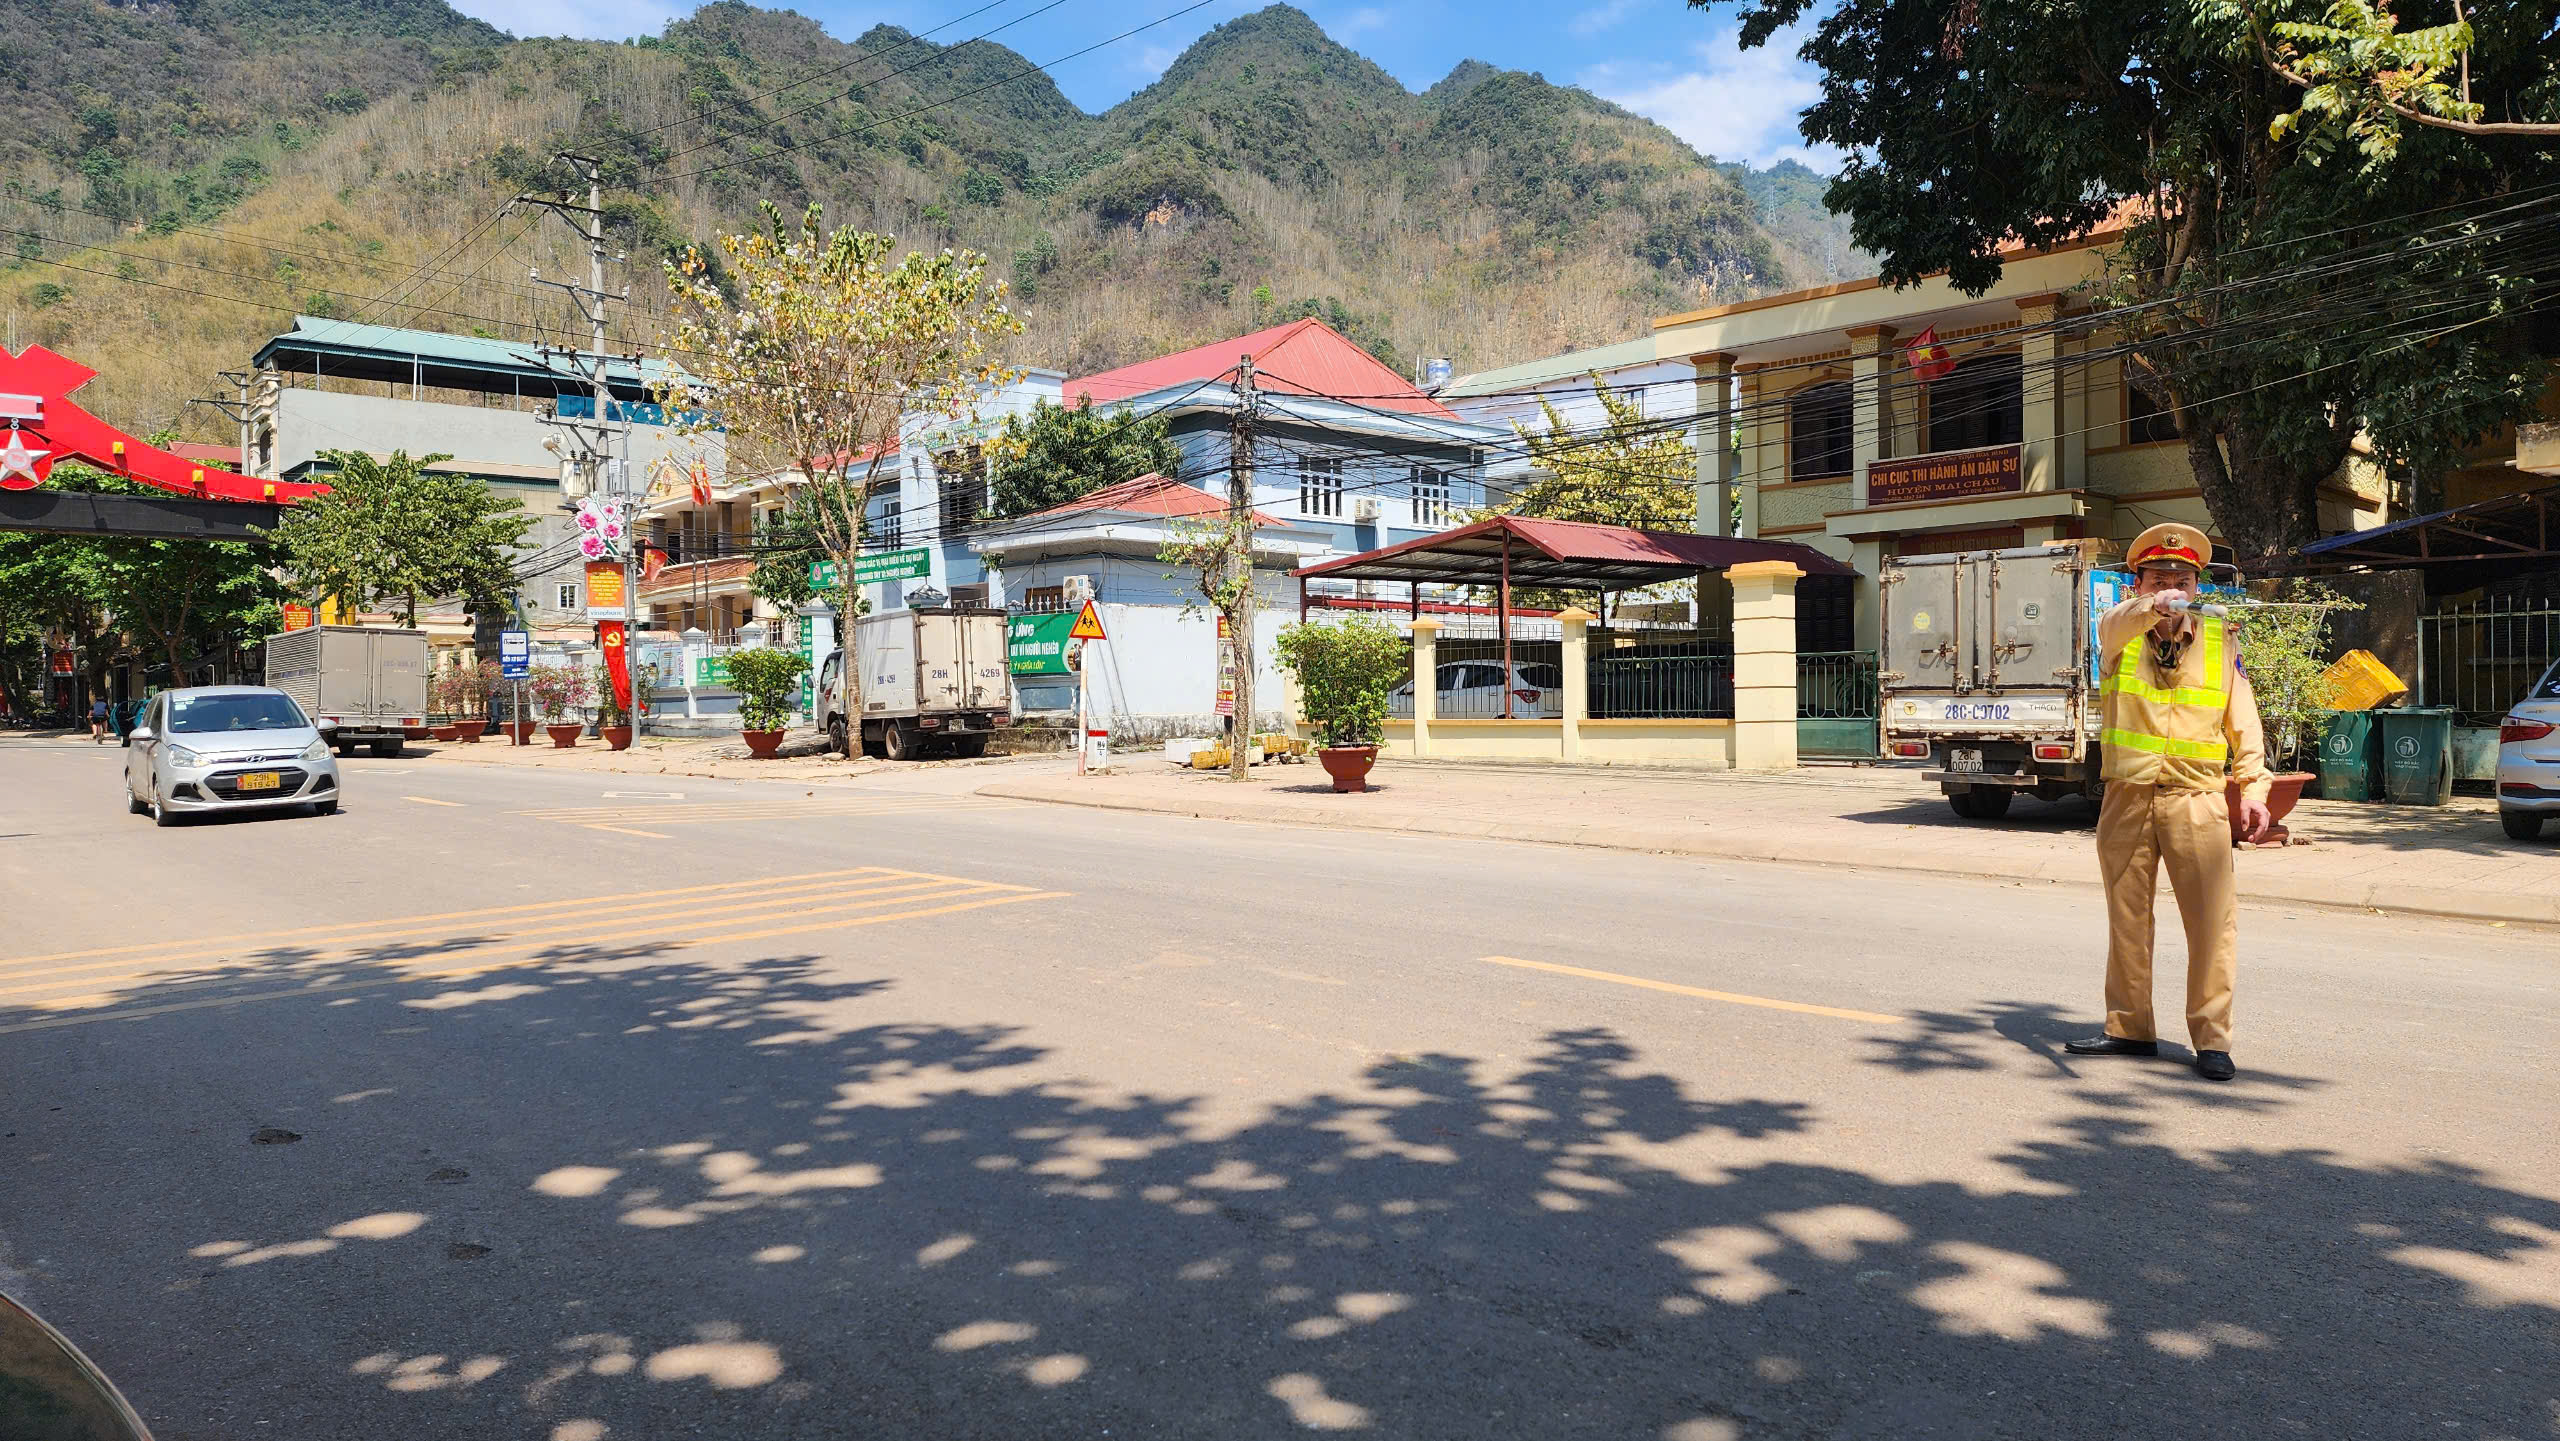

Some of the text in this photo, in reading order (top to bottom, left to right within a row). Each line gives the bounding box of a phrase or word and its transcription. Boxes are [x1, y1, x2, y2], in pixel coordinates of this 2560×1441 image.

[1871, 472, 1888, 487] CHI
[1889, 471, 1910, 487] CỤC
[1911, 468, 1927, 482] THI
[1929, 463, 1958, 480] HÀNH
[1960, 461, 1976, 477] ÁN
[1978, 459, 2000, 475] DÂN
[2002, 456, 2018, 475] SỰ
[1887, 484, 1932, 496] HUYỆN
[1935, 482, 1961, 491] MAI
[1964, 477, 2000, 488] CHÂU
[1025, 639, 1041, 656] NGƯỜI
[1041, 639, 1059, 655] NGHÈO
[932, 669, 949, 679] 28H
[980, 668, 1000, 678] 4269
[2029, 704, 2057, 712] THACO
[1952, 761, 1982, 772] 007.02
